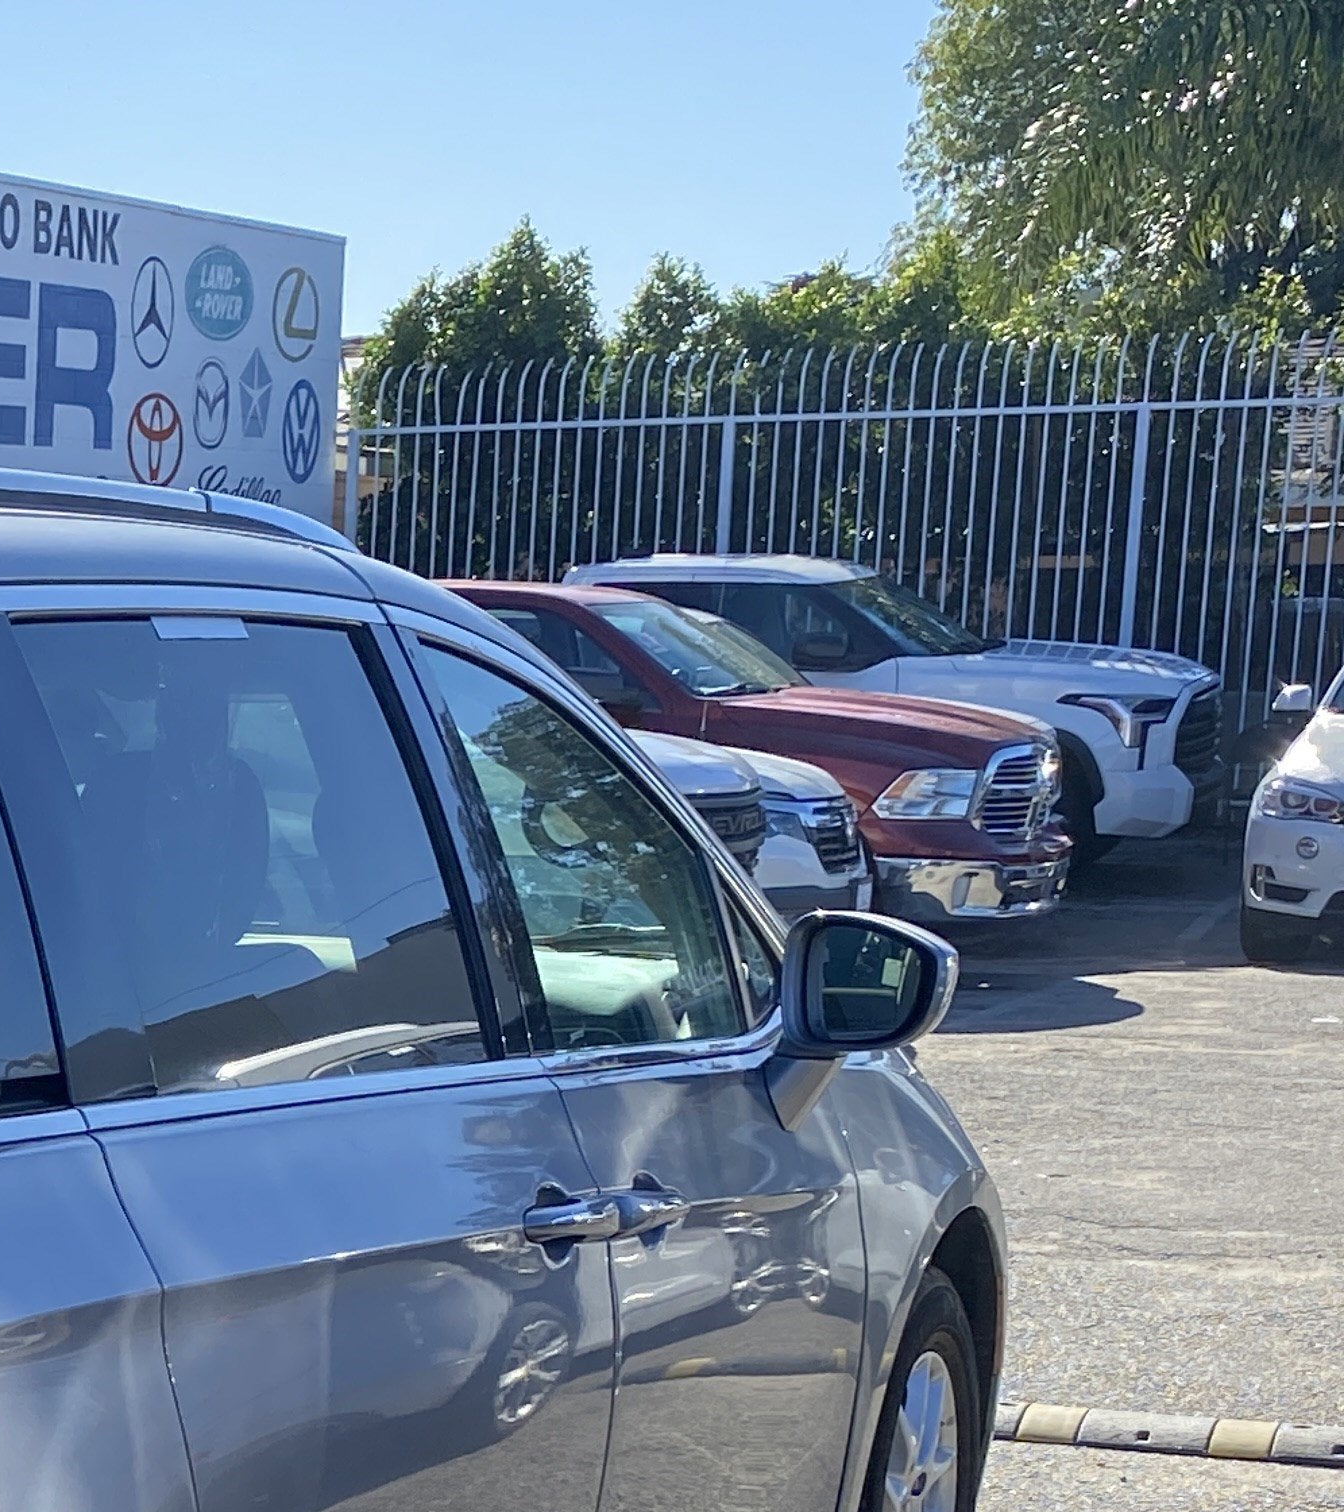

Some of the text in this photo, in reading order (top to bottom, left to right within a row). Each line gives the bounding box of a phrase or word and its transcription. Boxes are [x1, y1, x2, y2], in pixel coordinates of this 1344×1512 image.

[33, 198, 122, 266] BANK
[200, 263, 233, 291] LAND
[201, 293, 243, 321] ROVER
